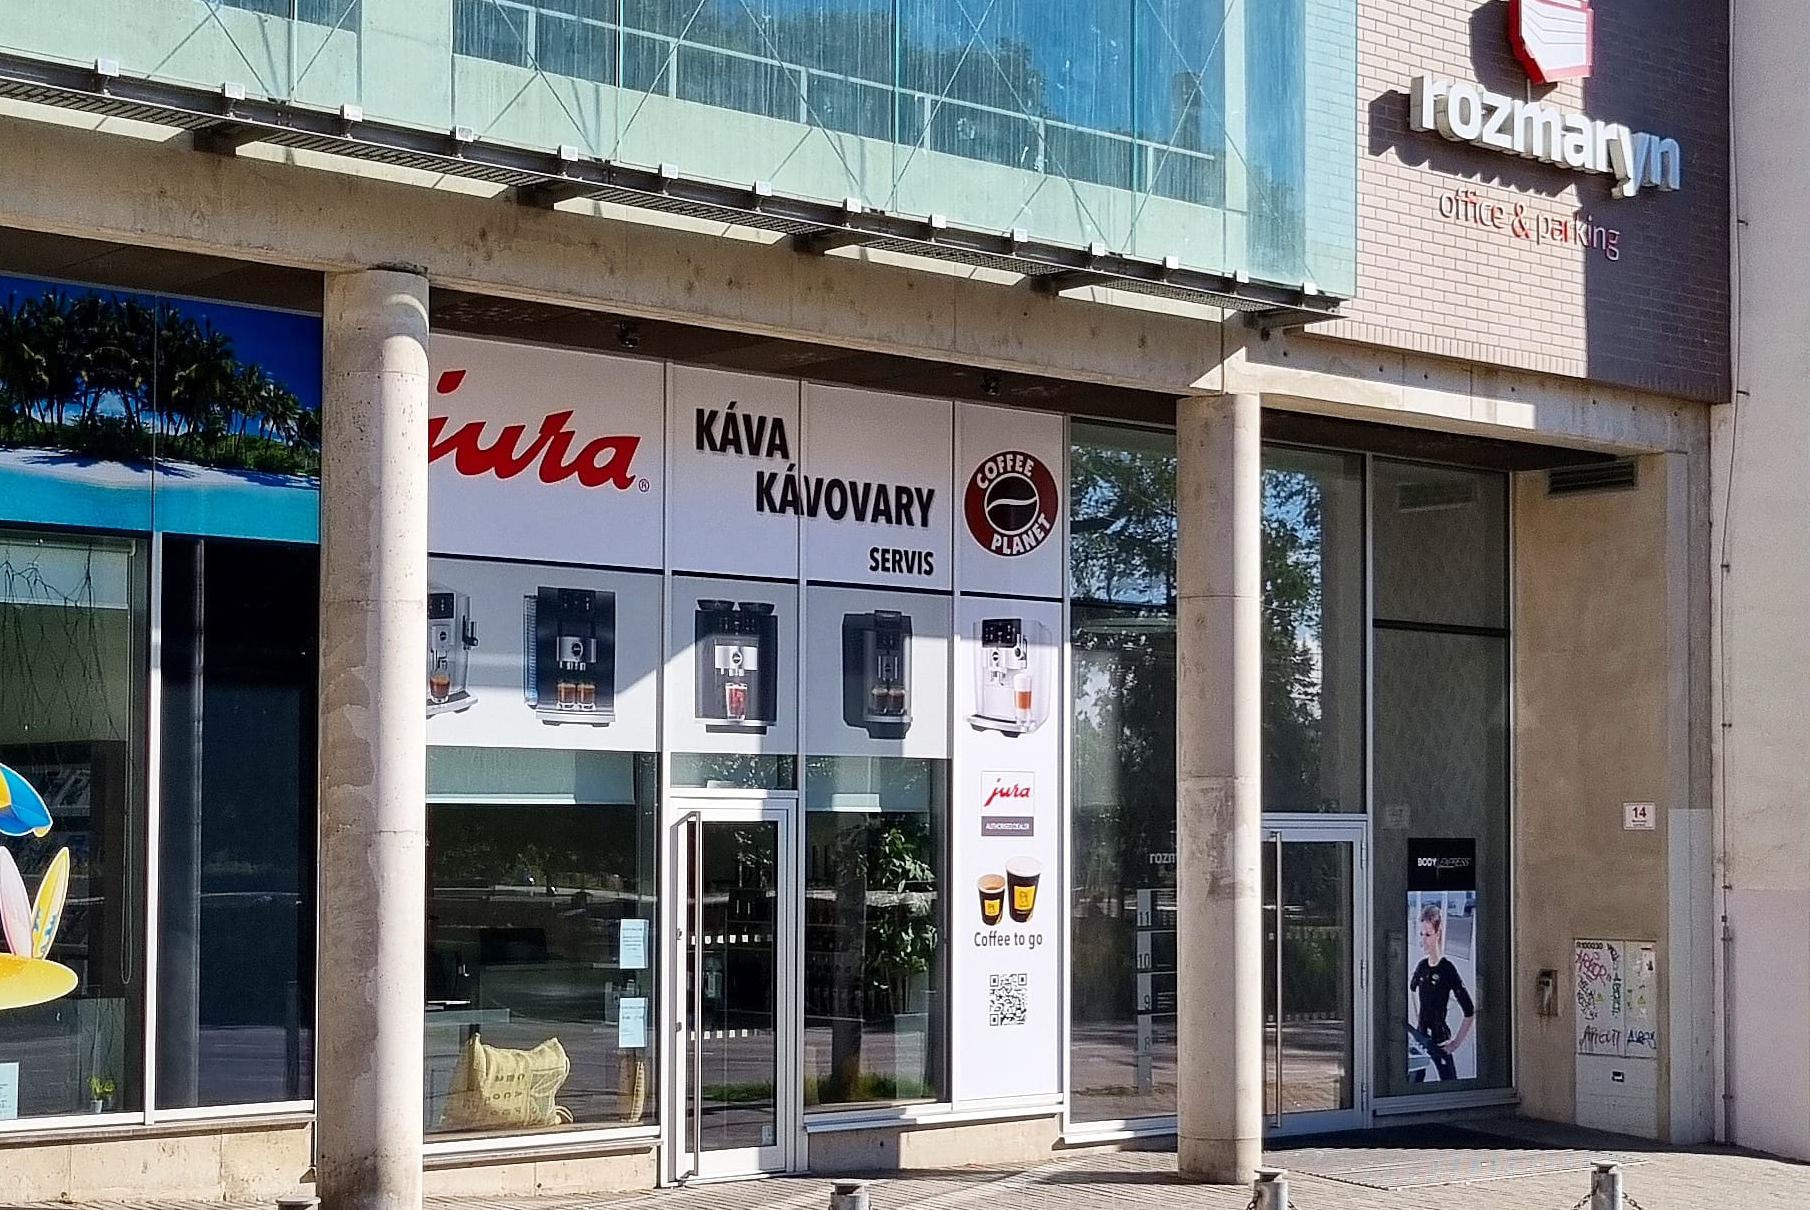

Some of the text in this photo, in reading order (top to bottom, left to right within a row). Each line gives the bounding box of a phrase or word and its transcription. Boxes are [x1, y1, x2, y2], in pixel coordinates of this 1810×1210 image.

[1412, 75, 1681, 198] rozmaryn
[1439, 187, 1620, 261] office & parking
[695, 401, 790, 459] KÁVA
[976, 454, 1034, 489] COFFEE
[756, 464, 935, 528] KÁVOVARY
[991, 512, 1050, 555] PLANET
[869, 546, 934, 576] SERVIS
[984, 777, 1031, 807] jura
[1632, 806, 1647, 818] 14
[1417, 857, 1437, 867] BODY
[974, 930, 1043, 950] Coffee to go
